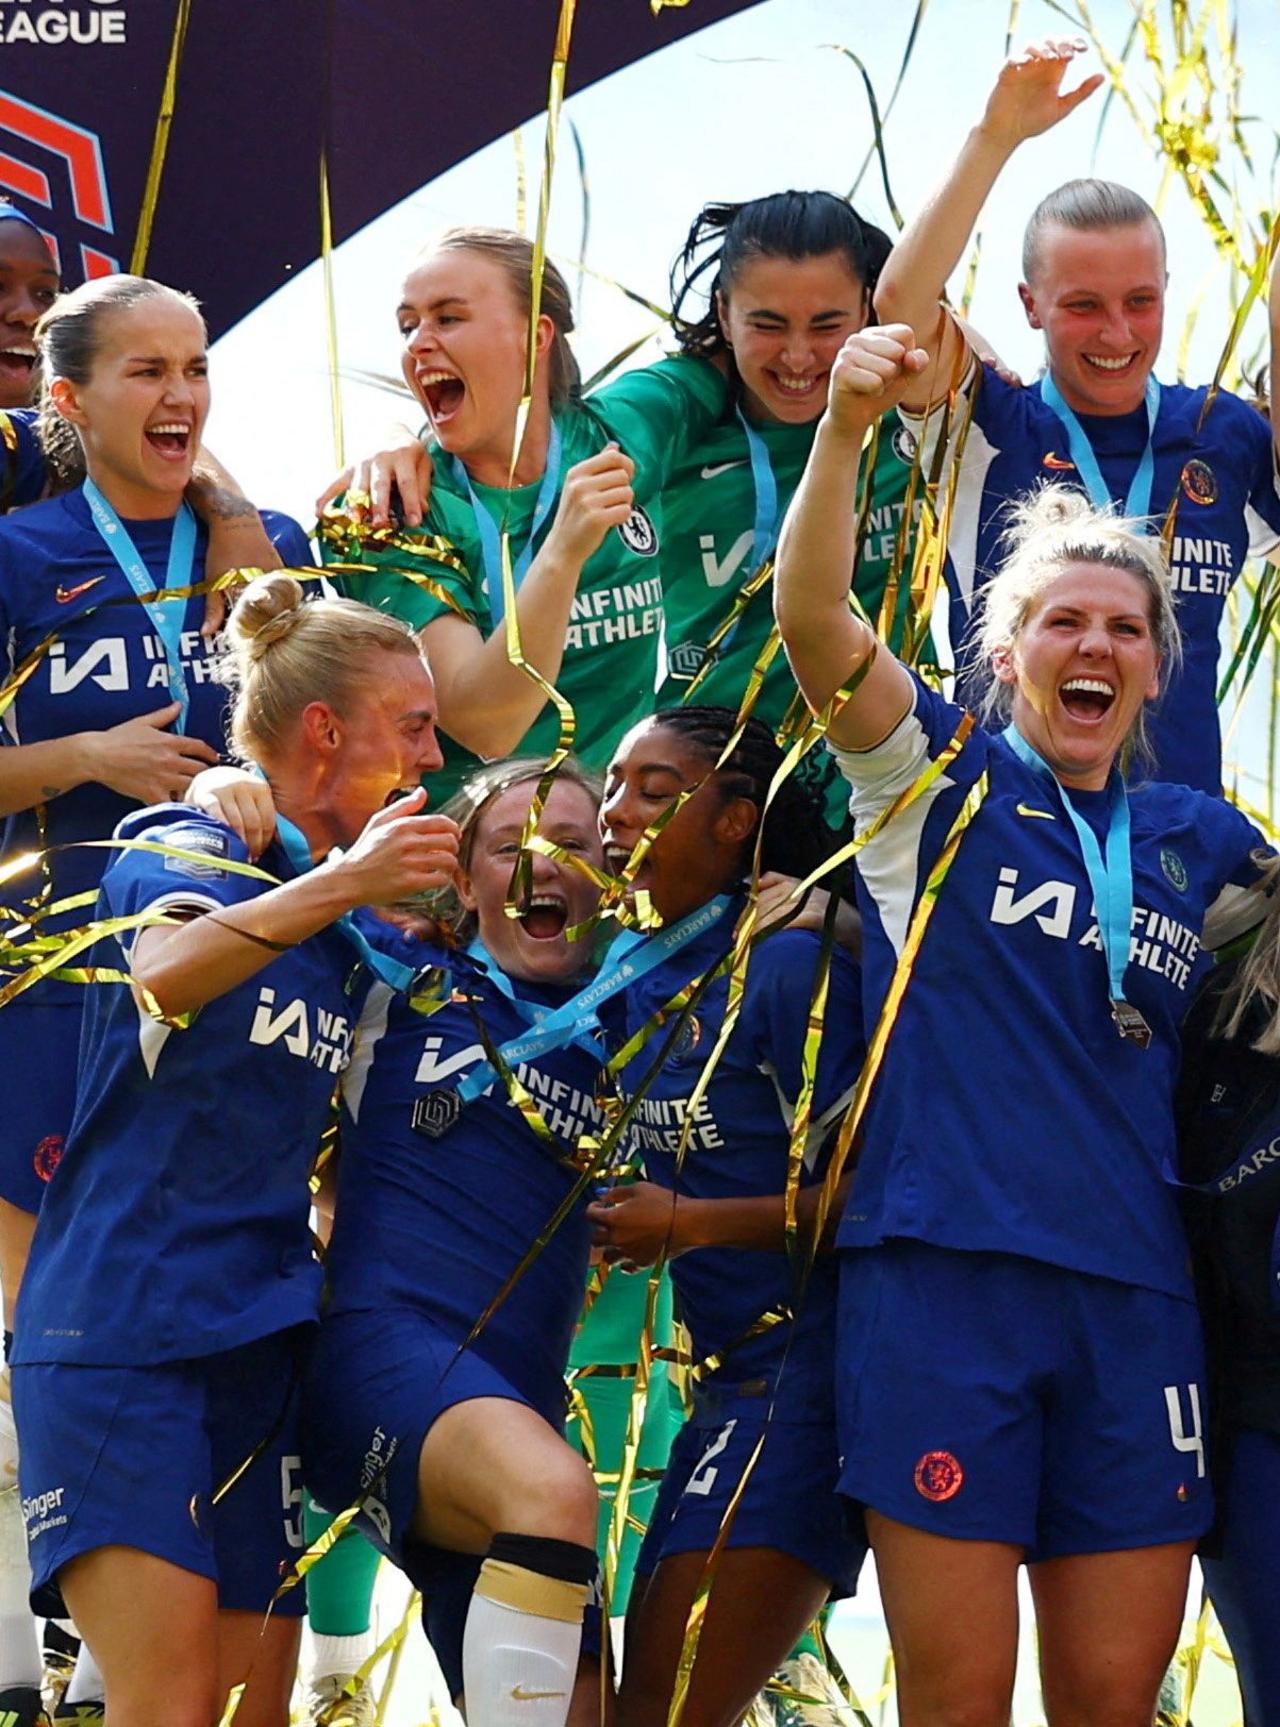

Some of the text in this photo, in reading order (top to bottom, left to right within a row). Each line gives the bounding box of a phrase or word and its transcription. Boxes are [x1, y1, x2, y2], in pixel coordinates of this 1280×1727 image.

[0, 9, 126, 44] AGUE
[664, 912, 711, 949] BARCLAYS
[1078, 925, 1192, 991] AHLETE
[576, 971, 623, 1010] BARCLAYS
[1163, 1383, 1206, 1478] 4
